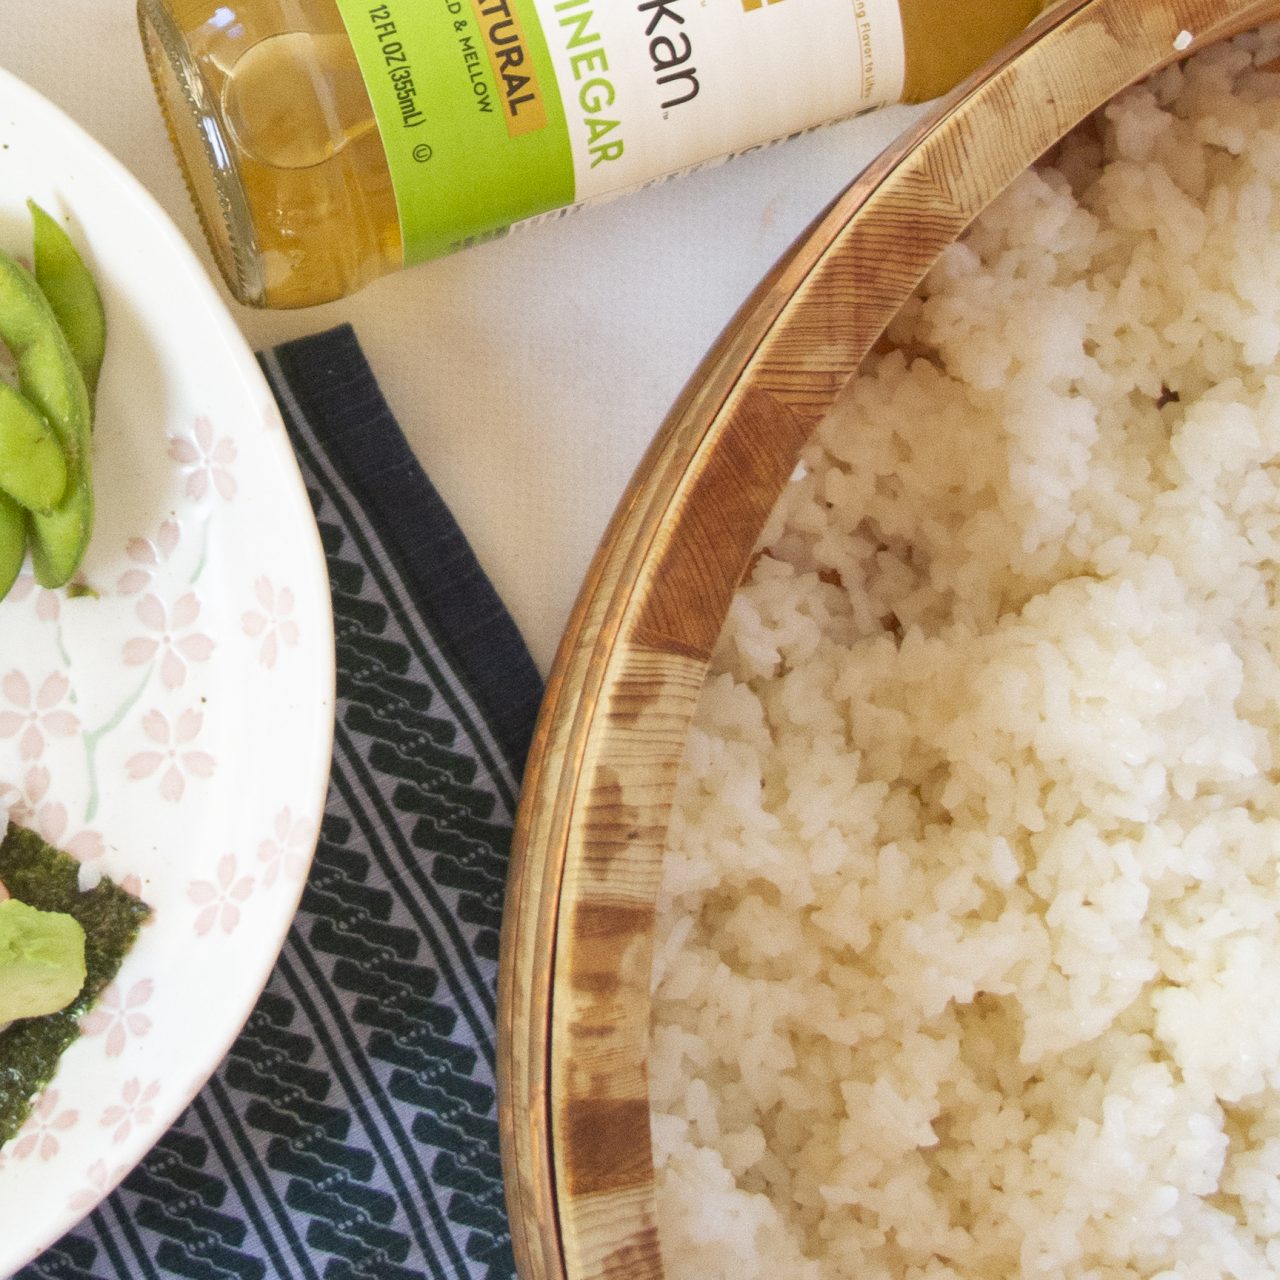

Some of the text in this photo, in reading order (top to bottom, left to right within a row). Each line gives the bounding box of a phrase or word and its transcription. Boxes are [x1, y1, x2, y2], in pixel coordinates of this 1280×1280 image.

[453, 19, 468, 33] &
[860, 22, 872, 60] Flavor
[368, 3, 427, 129] 12 FL OZ (355mL)
[458, 35, 493, 114] MELLOW
